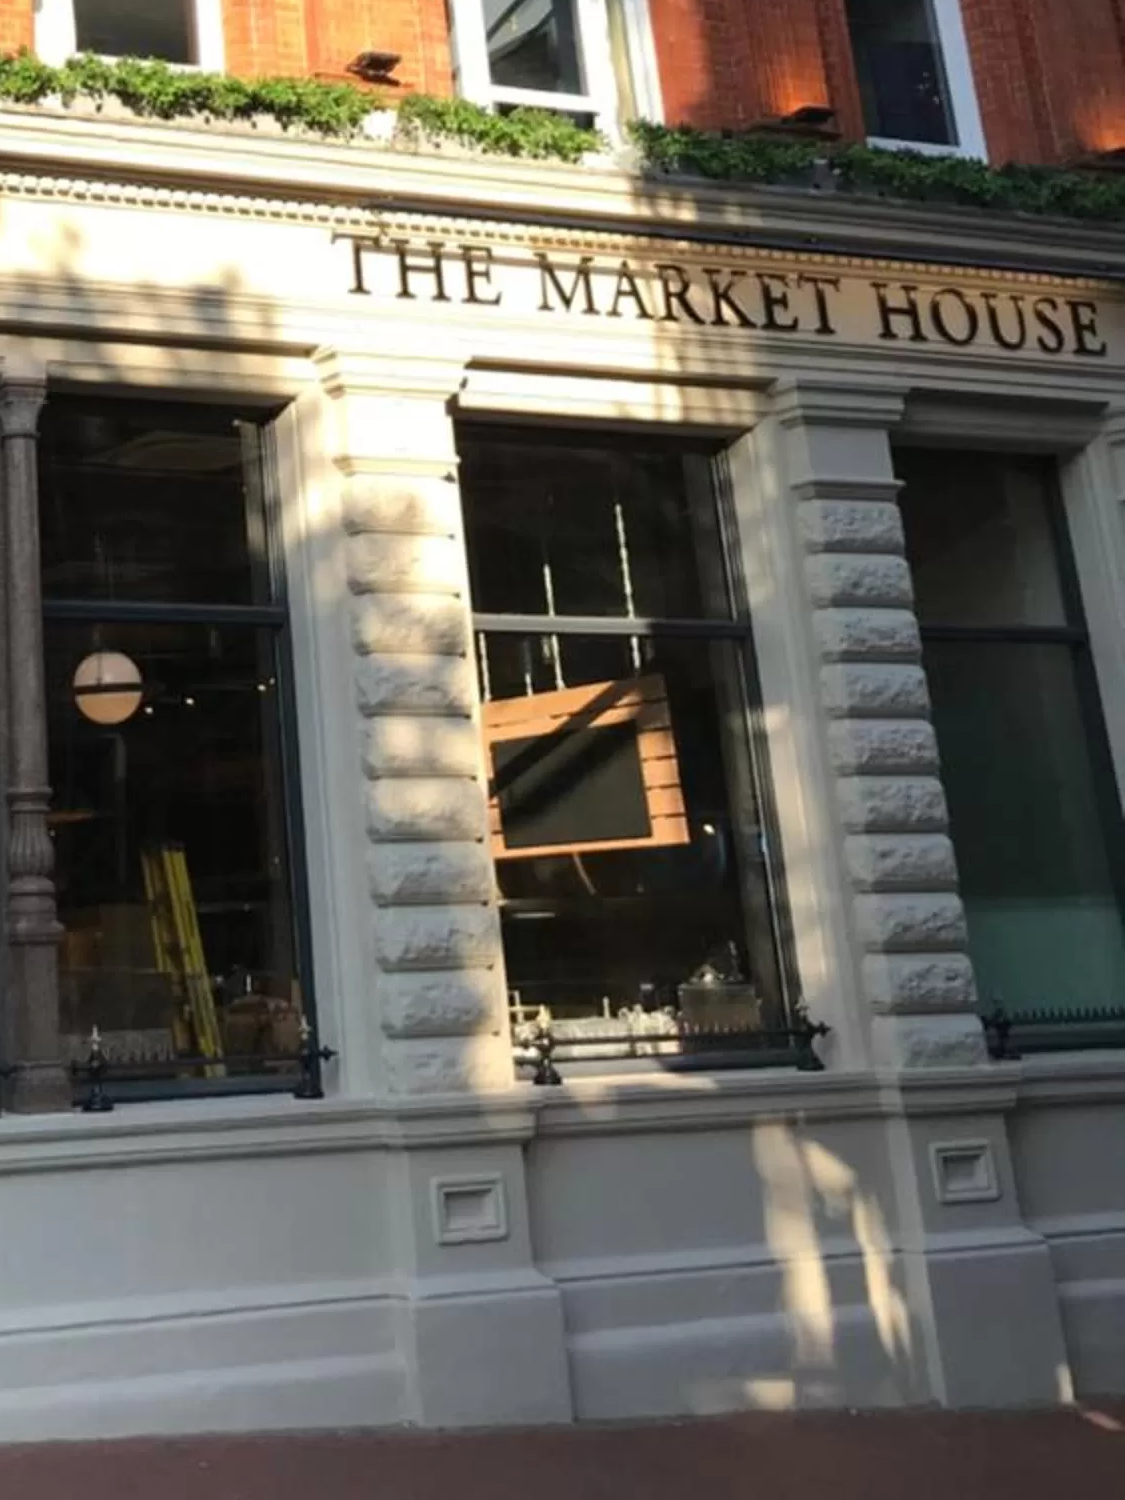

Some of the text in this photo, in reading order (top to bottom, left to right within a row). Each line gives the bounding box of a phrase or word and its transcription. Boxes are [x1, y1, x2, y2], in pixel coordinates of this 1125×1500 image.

[330, 230, 1107, 357] THE MARKET HOUSE
